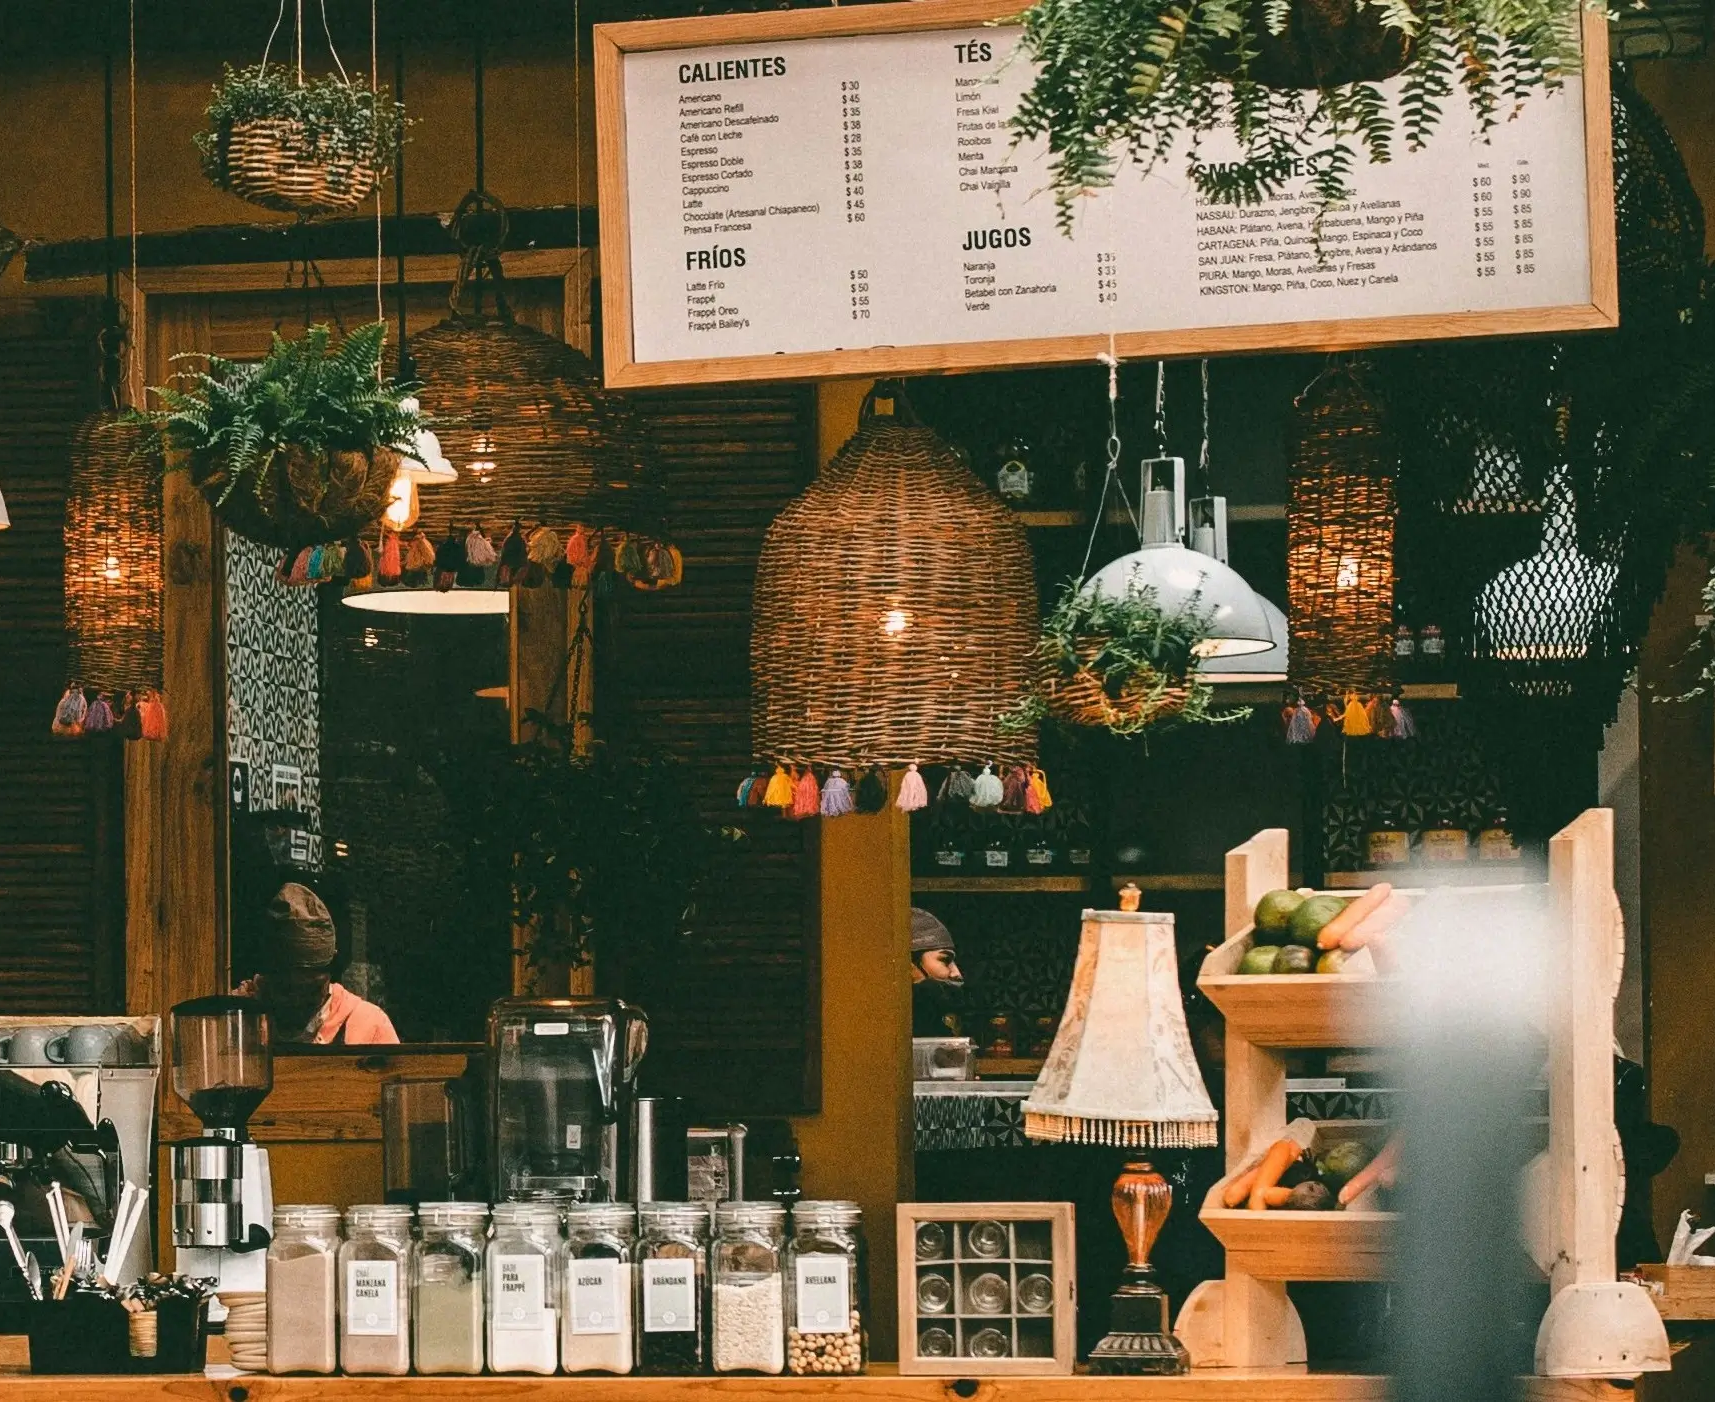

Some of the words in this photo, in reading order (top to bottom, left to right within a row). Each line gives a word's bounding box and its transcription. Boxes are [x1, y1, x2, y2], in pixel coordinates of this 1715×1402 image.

[954, 39, 992, 63] TÉS
[679, 57, 786, 83] CALIENTES
[849, 81, 859, 90] 30
[679, 94, 721, 104] Americano
[850, 94, 860, 103] 45
[956, 92, 981, 102] Limón
[679, 107, 721, 117] Americano
[724, 103, 743, 114] Refill
[850, 108, 860, 116] 35
[957, 107, 979, 116] Fresa
[983, 105, 999, 114] Kiwi
[680, 120, 722, 130] Americano
[725, 115, 779, 127] Descafeinado
[851, 121, 861, 129] 38
[957, 122, 983, 131] Frutas
[985, 121, 996, 129] de
[702, 134, 716, 142] con
[718, 132, 742, 140] Leche
[851, 134, 861, 142] 28
[958, 137, 992, 146] Rooibos
[681, 146, 718, 158] Espresso
[852, 148, 862, 156] 35
[958, 152, 984, 161] Menta
[682, 159, 718, 170] Espresso
[721, 157, 743, 166] Doble
[852, 160, 862, 169] 38
[959, 167, 978, 176] Chai
[682, 172, 719, 184] Espresso
[721, 169, 753, 179] Cortado
[853, 173, 863, 182] 40
[1520, 174, 1530, 183] 90
[1480, 177, 1491, 186] 60
[682, 185, 729, 197] Cappuccino
[853, 187, 864, 195] 40
[960, 182, 978, 191] Chai
[1481, 192, 1492, 201] 60
[1520, 189, 1531, 198] 90
[683, 200, 702, 208] Latte
[854, 200, 864, 208] 45
[1360, 200, 1401, 210] Avellanas
[1521, 204, 1532, 213] 85
[684, 211, 723, 222] Chocolate
[726, 207, 766, 220] (Artesanal
[769, 203, 820, 215] Chiapaneco)
[1482, 207, 1493, 216] 55
[855, 213, 865, 222] 60
[1366, 216, 1395, 225] Mango
[1397, 216, 1402, 224] y
[1483, 222, 1493, 231] 55
[1522, 219, 1532, 228] 85
[684, 224, 712, 235] Prensa
[714, 222, 751, 232] Francesa
[963, 227, 1031, 250] JUGOS
[1353, 231, 1390, 240] Espinaca
[1401, 228, 1423, 237] Coco
[1523, 234, 1533, 243] 85
[1483, 237, 1494, 246] 55
[687, 245, 746, 270] FRÍOS
[1198, 256, 1217, 266] SAN
[1355, 246, 1382, 256] Avena
[1385, 247, 1389, 255] y
[1484, 252, 1495, 261] 55
[1523, 249, 1534, 258] 85
[963, 262, 995, 272] Naranja
[1340, 264, 1344, 273] y
[1347, 262, 1375, 270] Fresas
[1485, 267, 1495, 276] 55
[1524, 264, 1535, 273] 85
[858, 270, 868, 279] 50
[964, 275, 995, 285] Toronja
[1337, 277, 1359, 286] Nuez
[1361, 277, 1365, 286] y
[1369, 274, 1398, 284] Canela
[686, 282, 706, 291] Latte
[859, 283, 868, 292] 50
[965, 288, 996, 298] Betabel
[998, 287, 1013, 295] con
[1016, 284, 1056, 295] Zanahoria
[859, 296, 869, 305] 55
[719, 306, 738, 315] Oreo
[966, 302, 990, 311] Verde
[860, 310, 870, 318] 70
[805, 1276, 837, 1284] AVELLANA
[356, 1289, 379, 1297] CANELA
